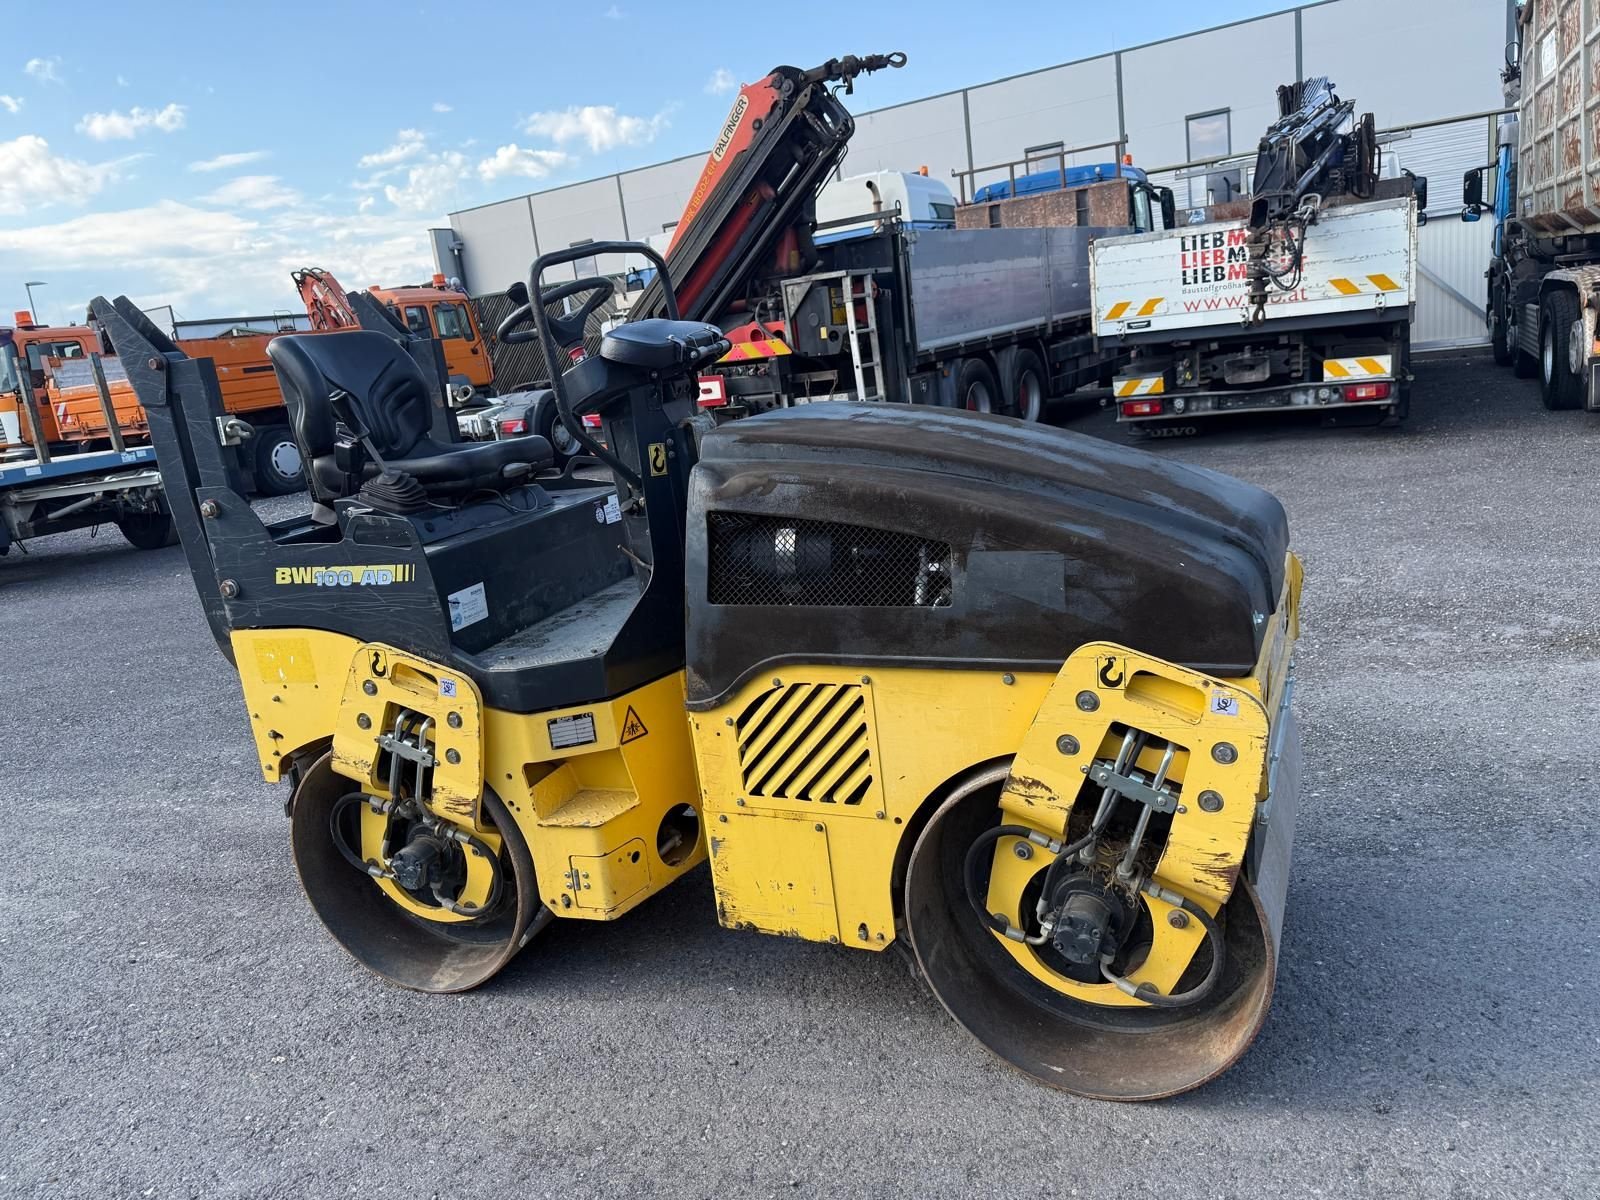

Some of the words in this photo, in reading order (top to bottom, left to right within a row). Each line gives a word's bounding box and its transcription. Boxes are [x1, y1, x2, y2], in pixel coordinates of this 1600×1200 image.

[714, 98, 747, 158] PALFINGER
[1146, 427, 1197, 438] OLVO
[275, 566, 312, 585] BW
[314, 570, 353, 587] 100
[360, 569, 393, 586] AD
